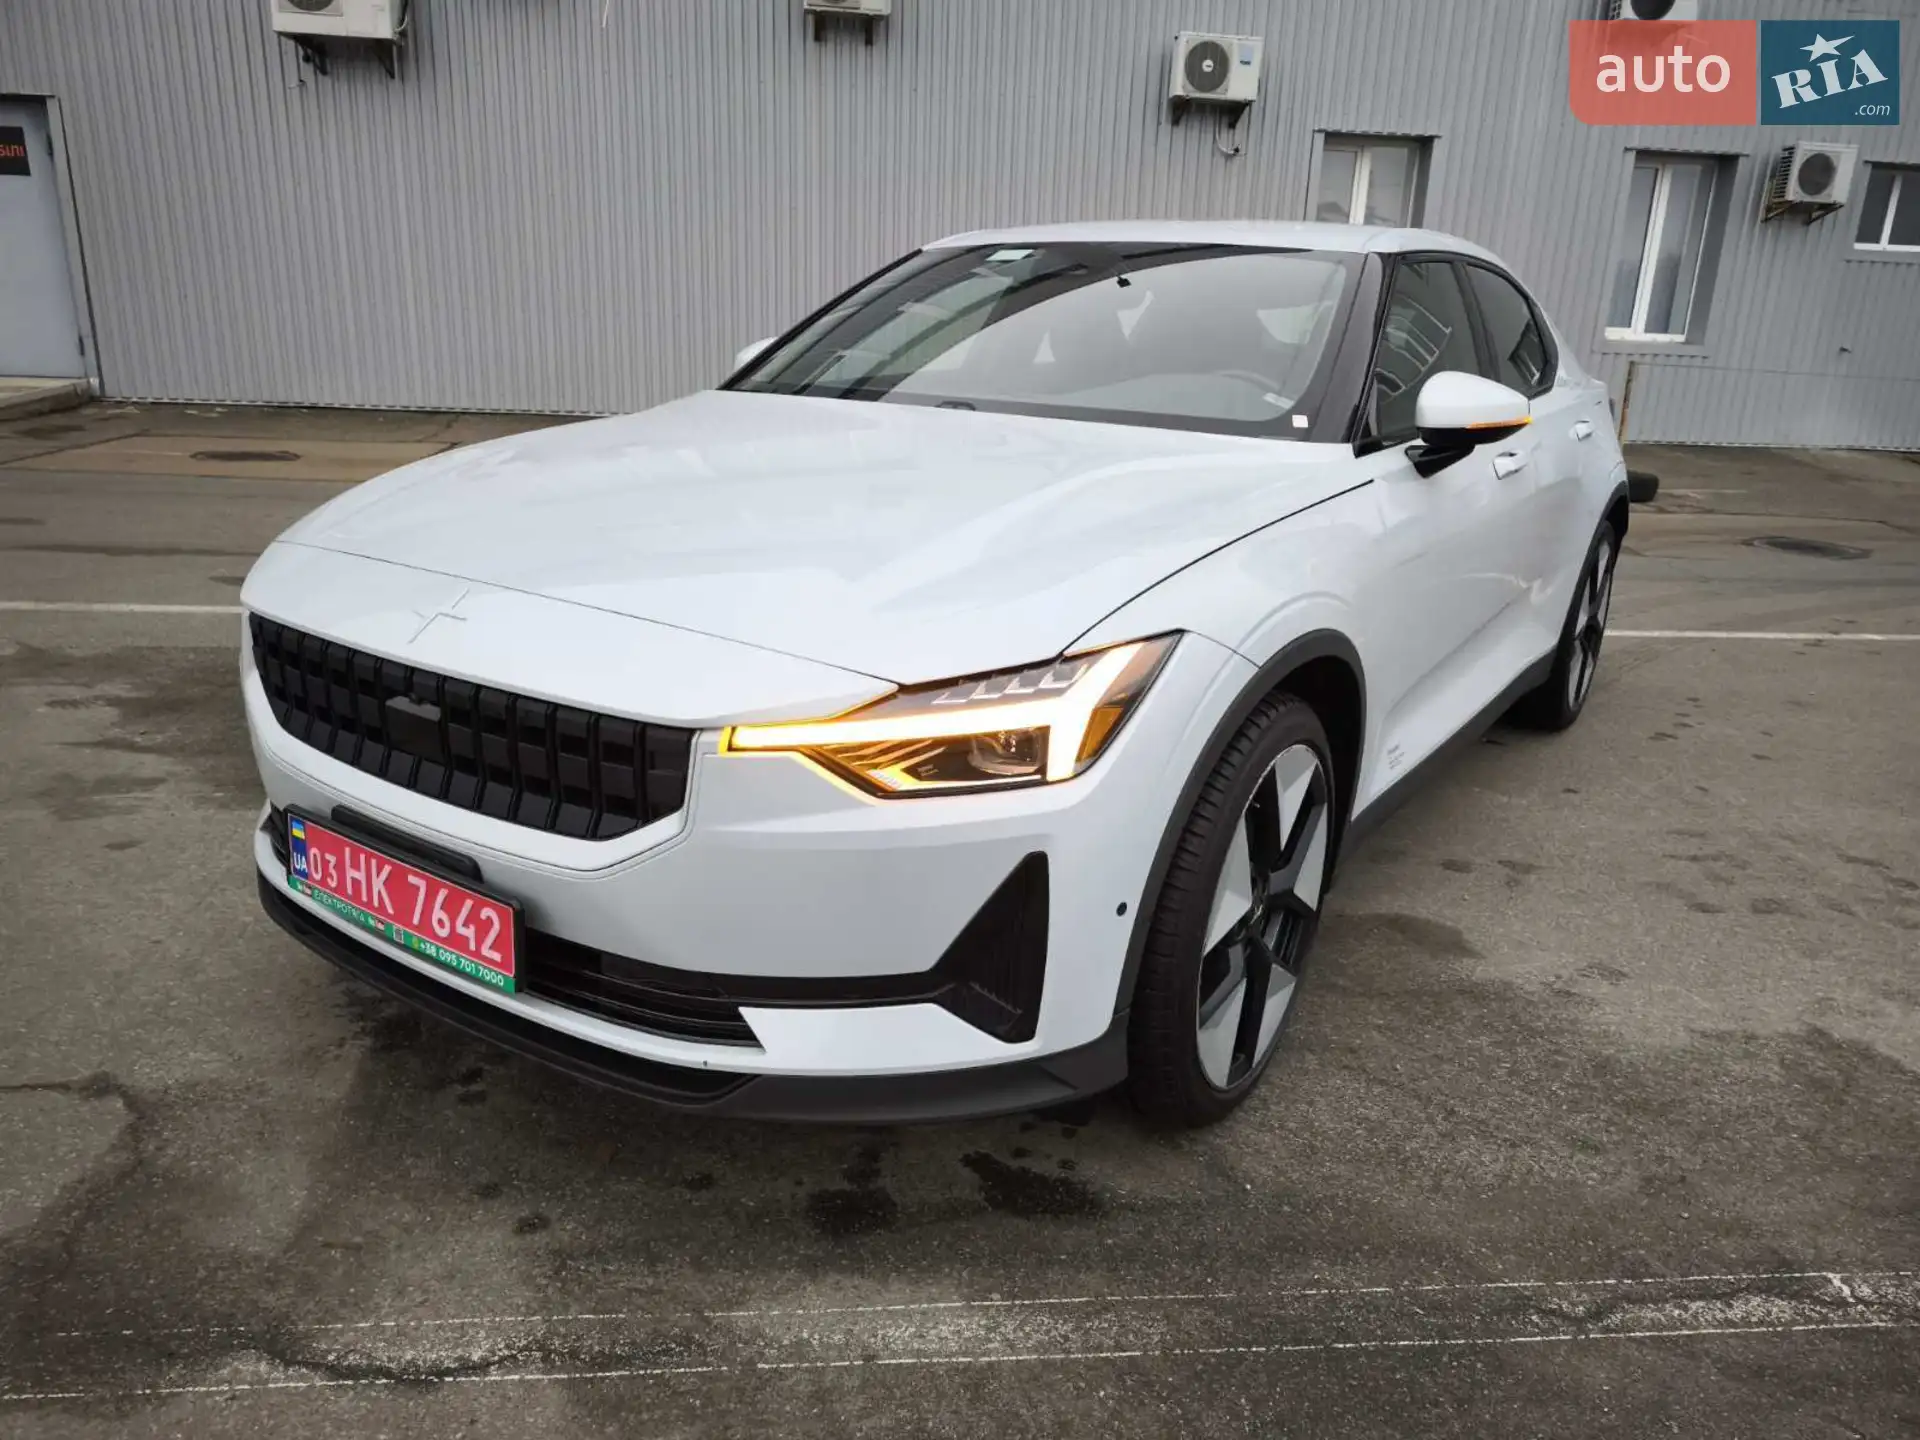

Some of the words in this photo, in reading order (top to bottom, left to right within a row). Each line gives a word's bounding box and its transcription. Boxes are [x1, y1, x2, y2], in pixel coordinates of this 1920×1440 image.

[294, 852, 308, 873] UA
[309, 847, 338, 888] 03
[345, 847, 394, 915] HK
[407, 874, 503, 962] 7642
[438, 949, 457, 966] 095
[459, 957, 476, 975] 701
[478, 965, 505, 987] 7000
